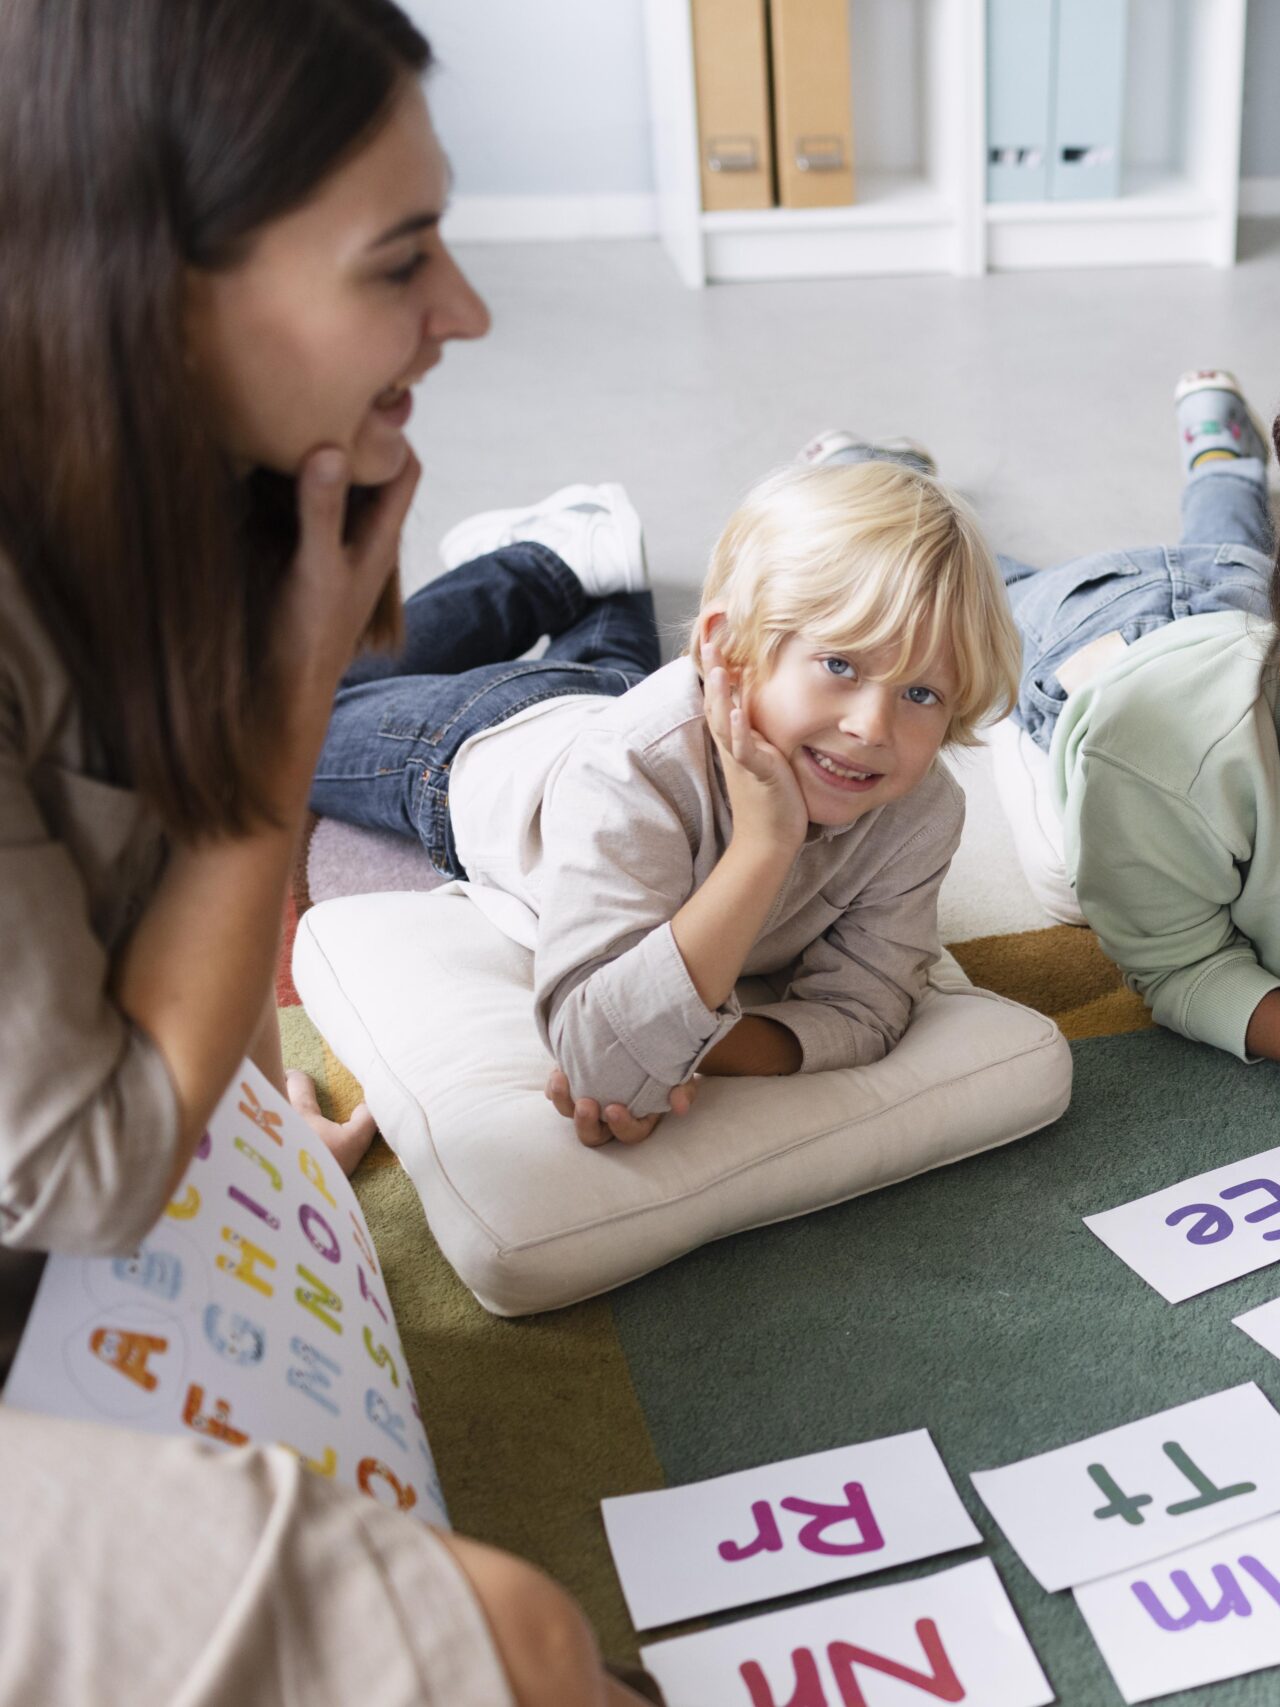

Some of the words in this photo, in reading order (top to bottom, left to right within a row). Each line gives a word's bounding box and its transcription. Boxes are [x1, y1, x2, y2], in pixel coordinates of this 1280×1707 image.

[238, 1081, 285, 1147] K
[234, 1136, 283, 1192] J
[298, 1148, 337, 1209] P
[215, 1226, 277, 1297] H
[299, 1204, 342, 1265] O
[294, 1263, 343, 1336] N
[89, 1327, 168, 1392] A
[203, 1302, 267, 1368] G
[287, 1336, 343, 1418] M
[182, 1382, 250, 1447] F
[364, 1387, 409, 1452] R
[1086, 1440, 1257, 1526] Tt
[717, 1481, 886, 1563] Rr
[738, 1617, 967, 1707] Nn
